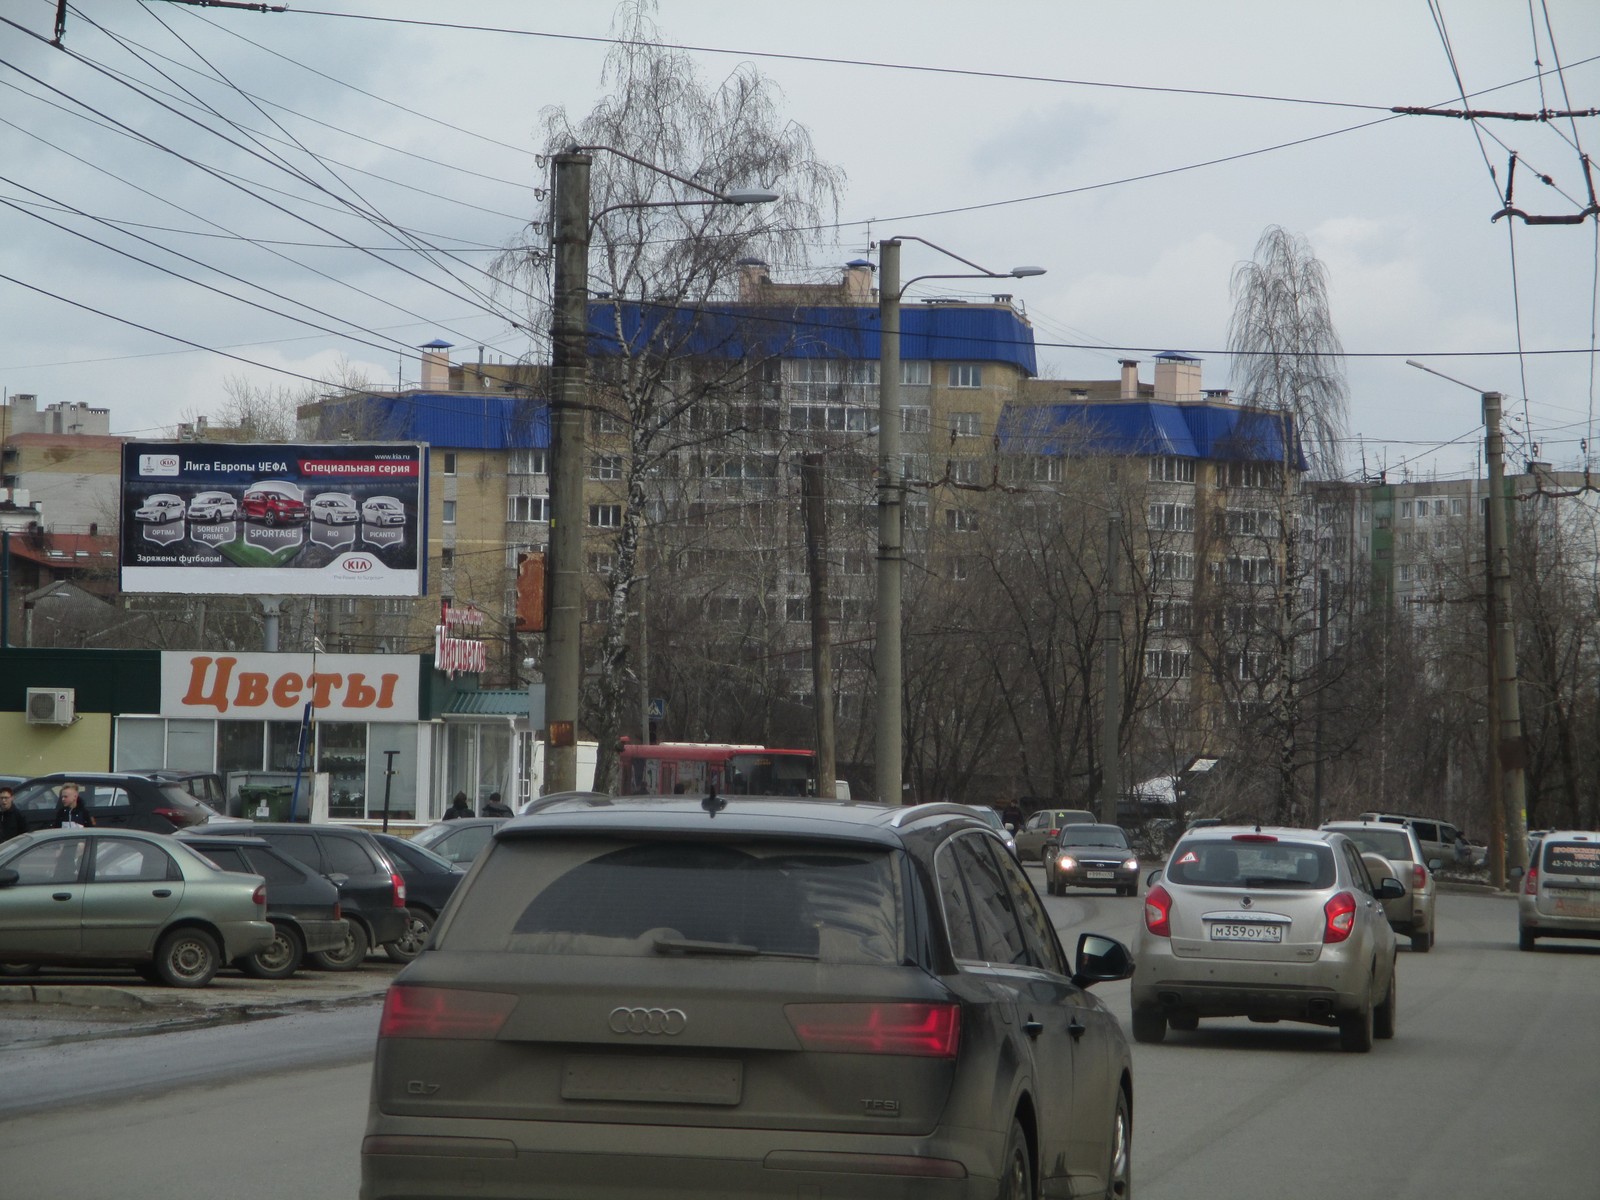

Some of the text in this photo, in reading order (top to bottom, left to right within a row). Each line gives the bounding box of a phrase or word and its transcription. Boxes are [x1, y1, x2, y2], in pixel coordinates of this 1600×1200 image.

[184, 461, 287, 473] Лига Европы УЕФА
[304, 462, 410, 474] Специальная серия
[250, 529, 297, 538] SPORTAGE
[137, 554, 222, 564] Заряжены футболом!
[346, 561, 368, 569] KIA
[181, 656, 399, 713] Цветы
[408, 1080, 440, 1094] Q7
[860, 1099, 900, 1109] TFSI
